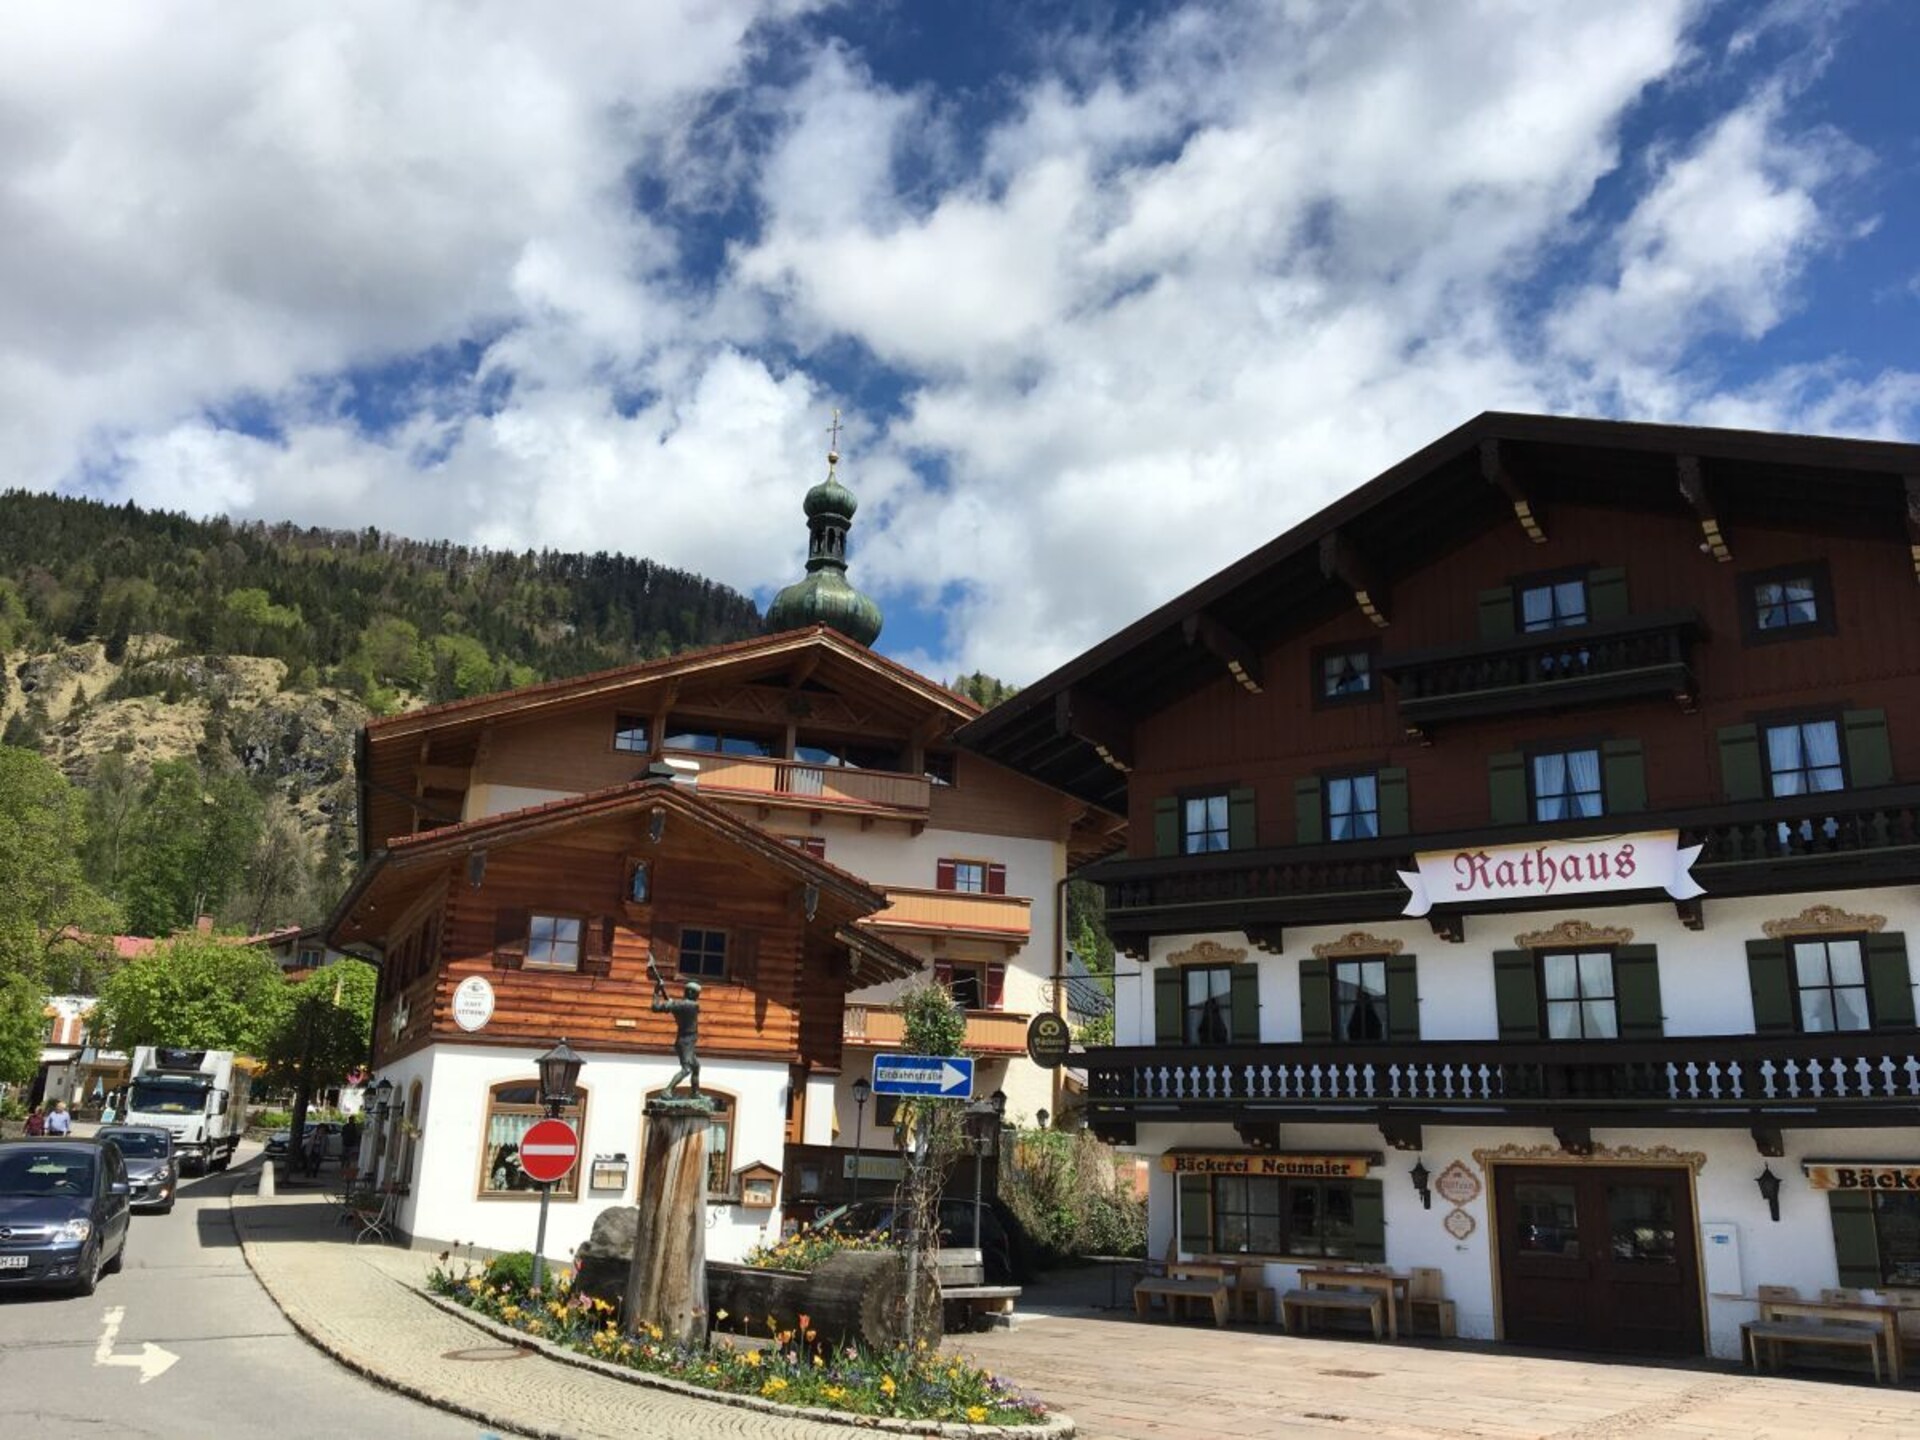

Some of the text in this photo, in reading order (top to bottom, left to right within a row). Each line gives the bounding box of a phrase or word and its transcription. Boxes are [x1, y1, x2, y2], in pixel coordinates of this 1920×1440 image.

[1453, 843, 1636, 893] Rathaus
[1175, 1157, 1350, 1175] Bäckerei Neumaier
[1835, 1167, 1920, 1189] Bäck
[0, 1256, 26, 1267] H111
